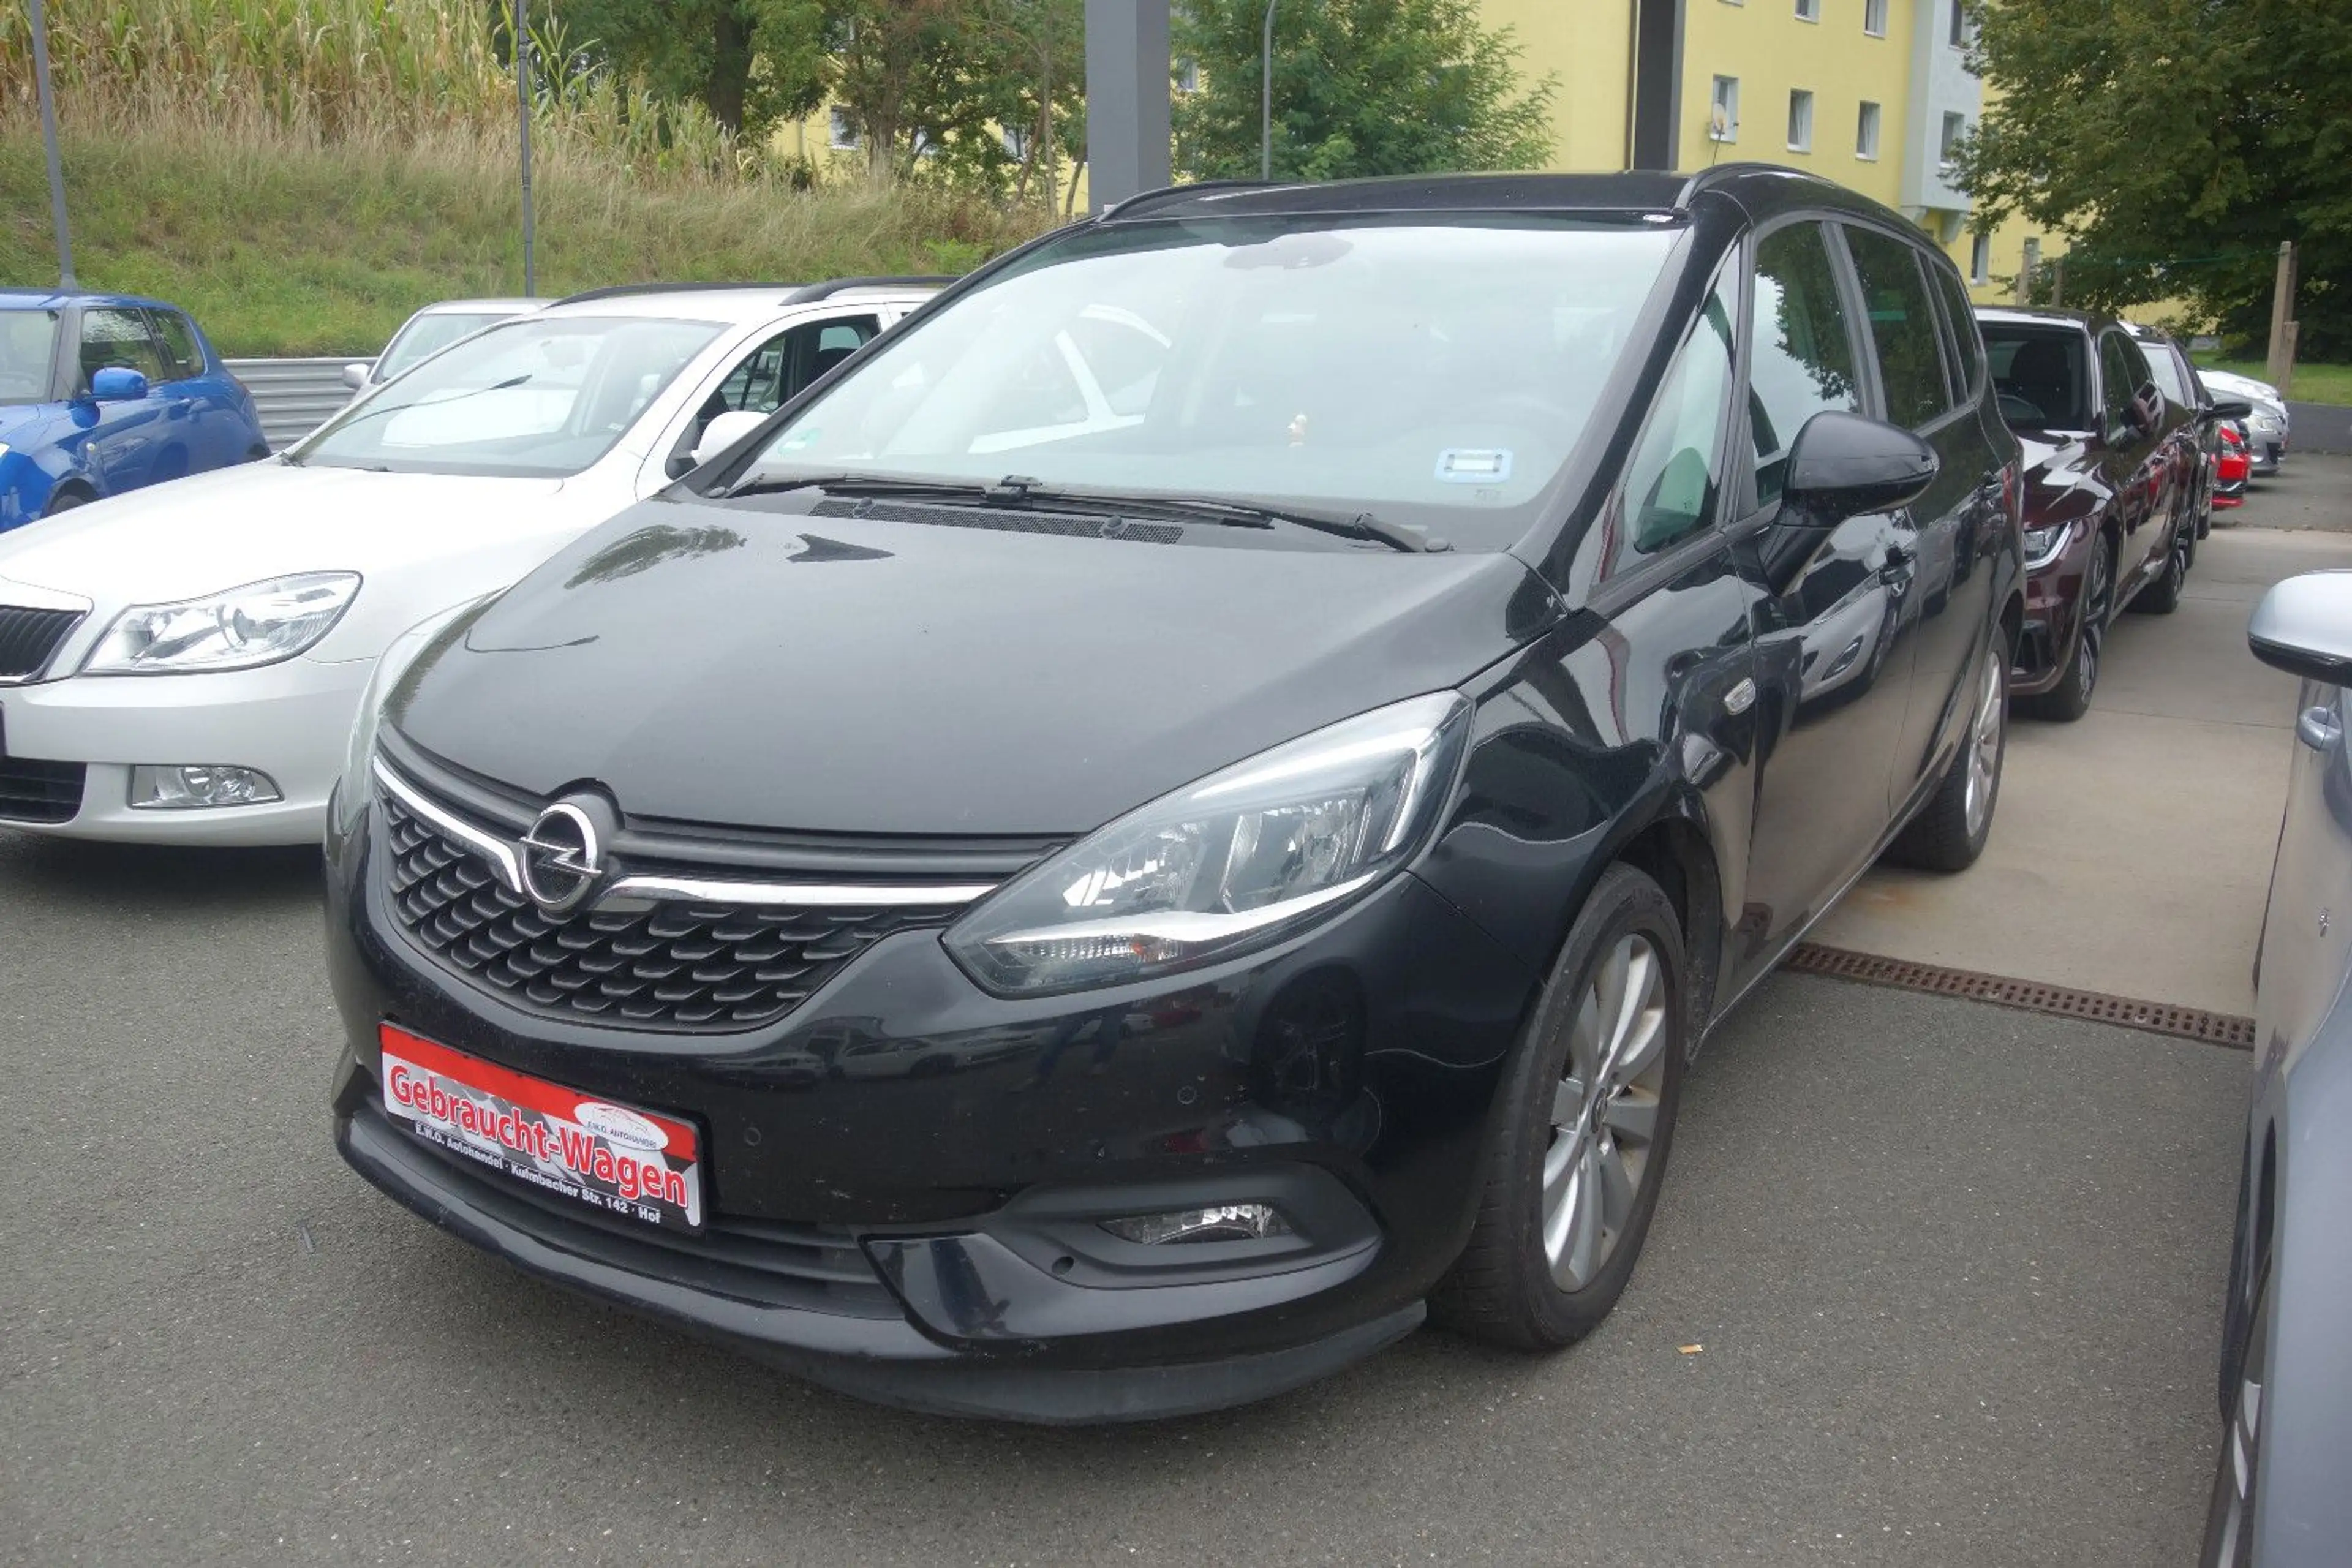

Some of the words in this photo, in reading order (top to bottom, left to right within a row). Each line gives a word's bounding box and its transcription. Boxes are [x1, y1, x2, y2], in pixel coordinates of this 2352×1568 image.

[389, 1064, 687, 1208] Gebraucht-Wagen
[447, 1137, 503, 1169] Autohandel
[511, 1163, 579, 1197] Kulmbacher
[582, 1188, 603, 1205] Str.
[605, 1197, 628, 1213] 142
[638, 1207, 661, 1224] Hof
